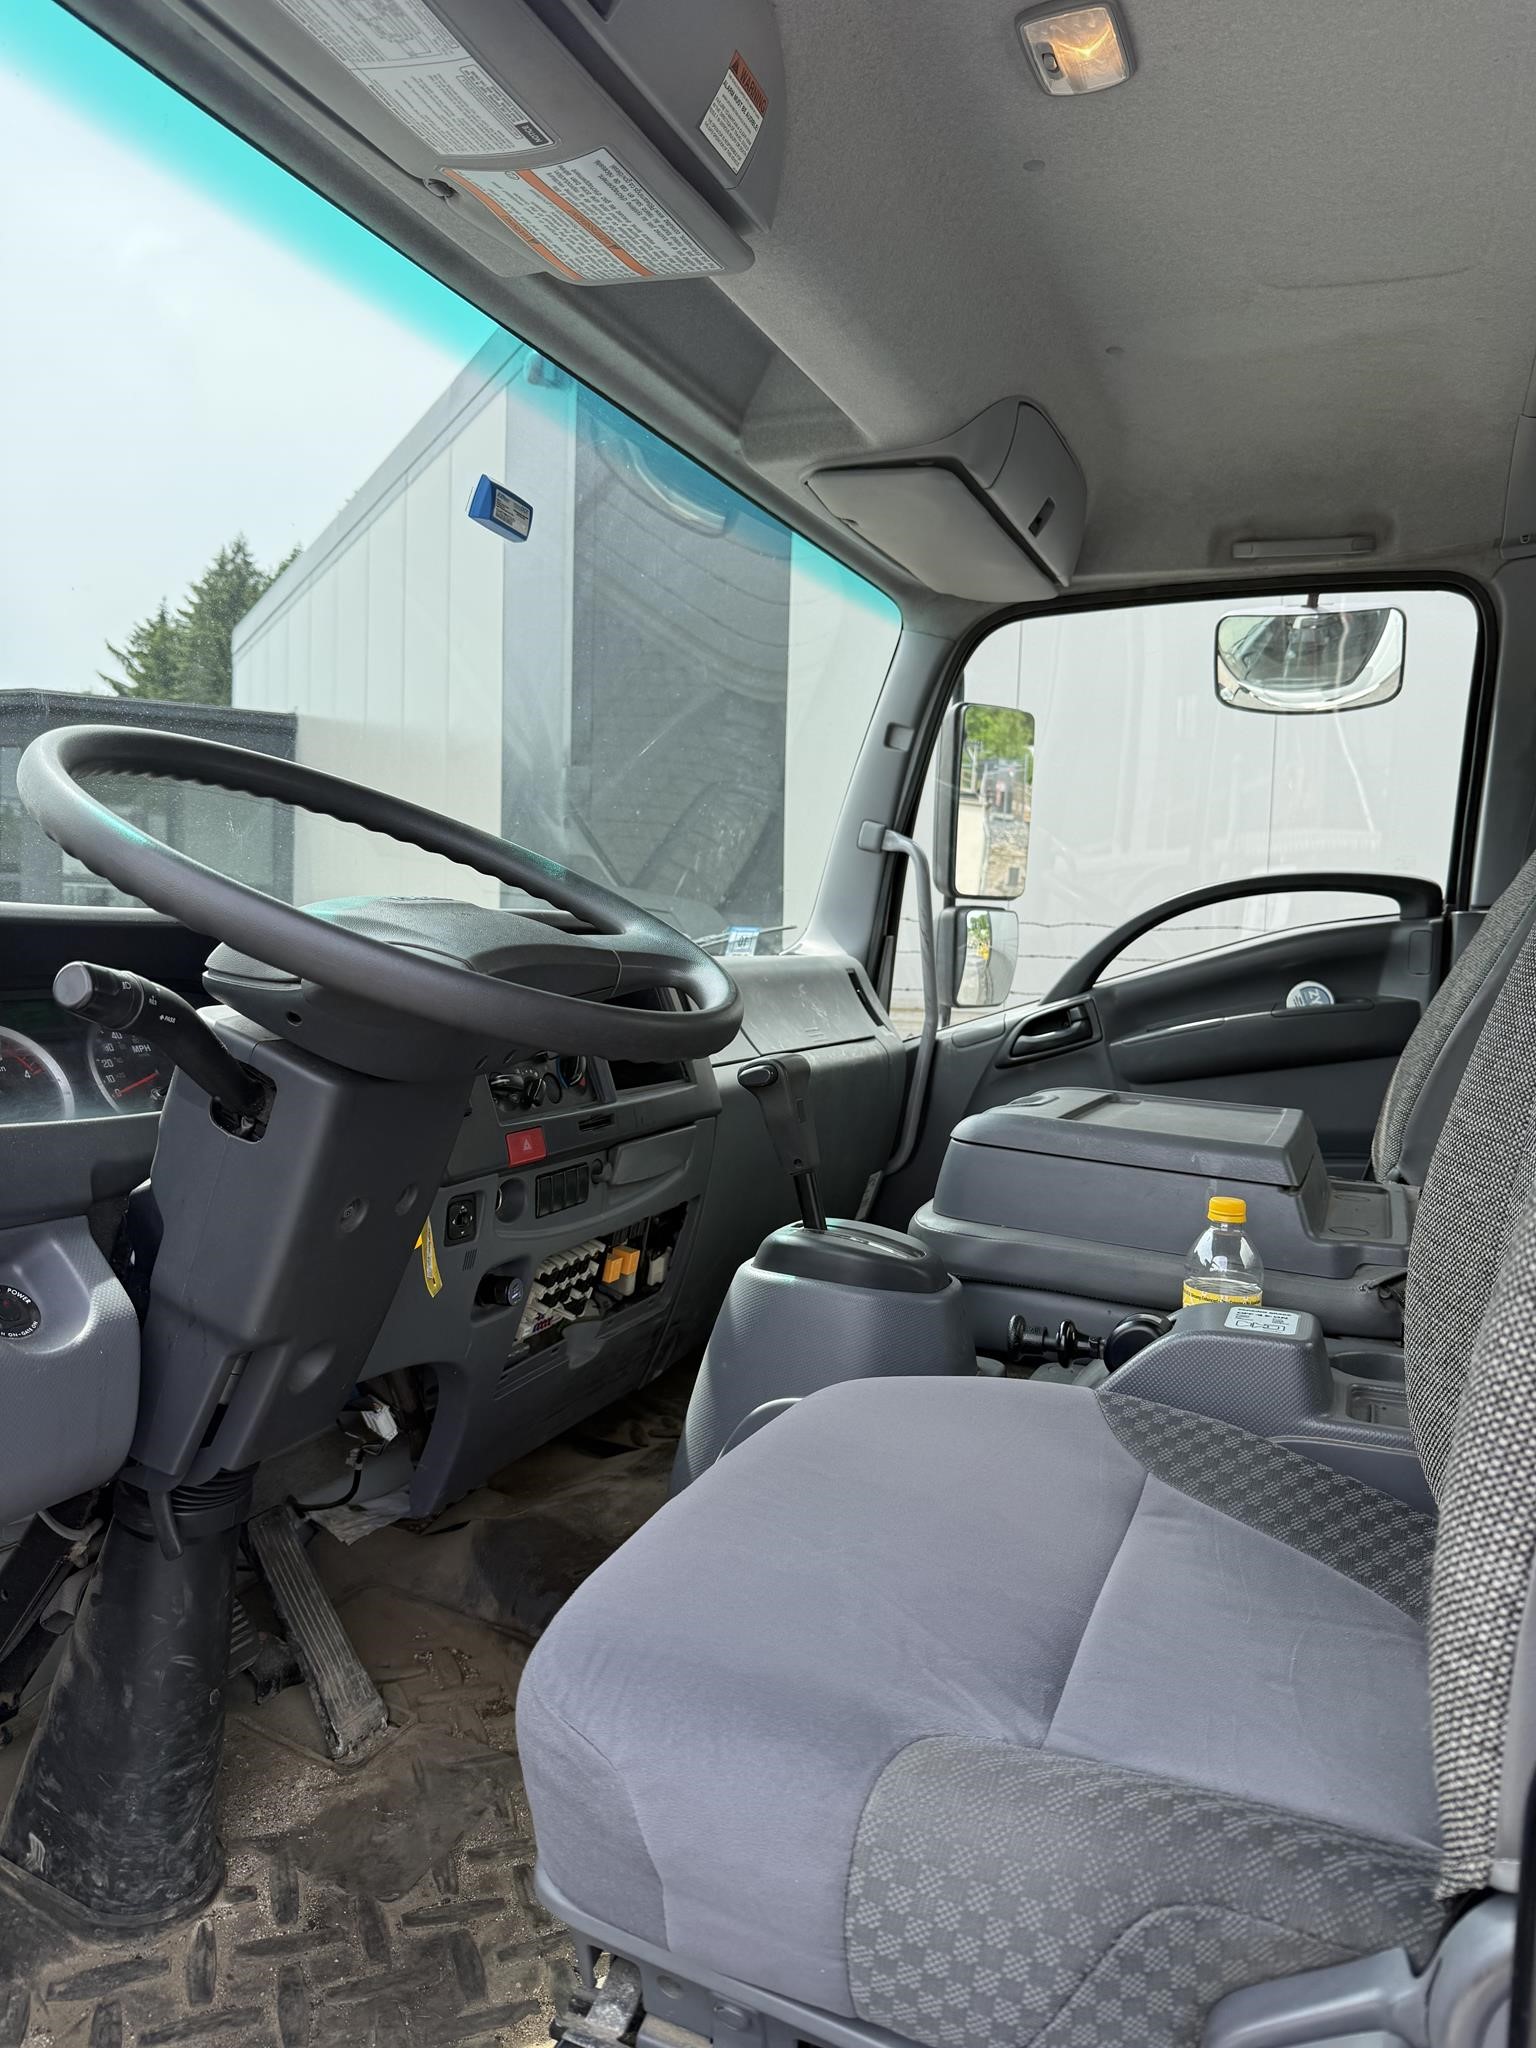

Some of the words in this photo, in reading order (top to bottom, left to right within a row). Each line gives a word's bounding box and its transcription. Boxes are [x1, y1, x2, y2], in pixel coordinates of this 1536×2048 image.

[738, 66, 768, 114] WARNING
[522, 125, 544, 142] NOTICE
[131, 1044, 152, 1054] MPH
[102, 1058, 114, 1068] 20
[24, 1069, 32, 1079] 4
[106, 1074, 116, 1083] 10
[7, 1287, 31, 1304] POWER
